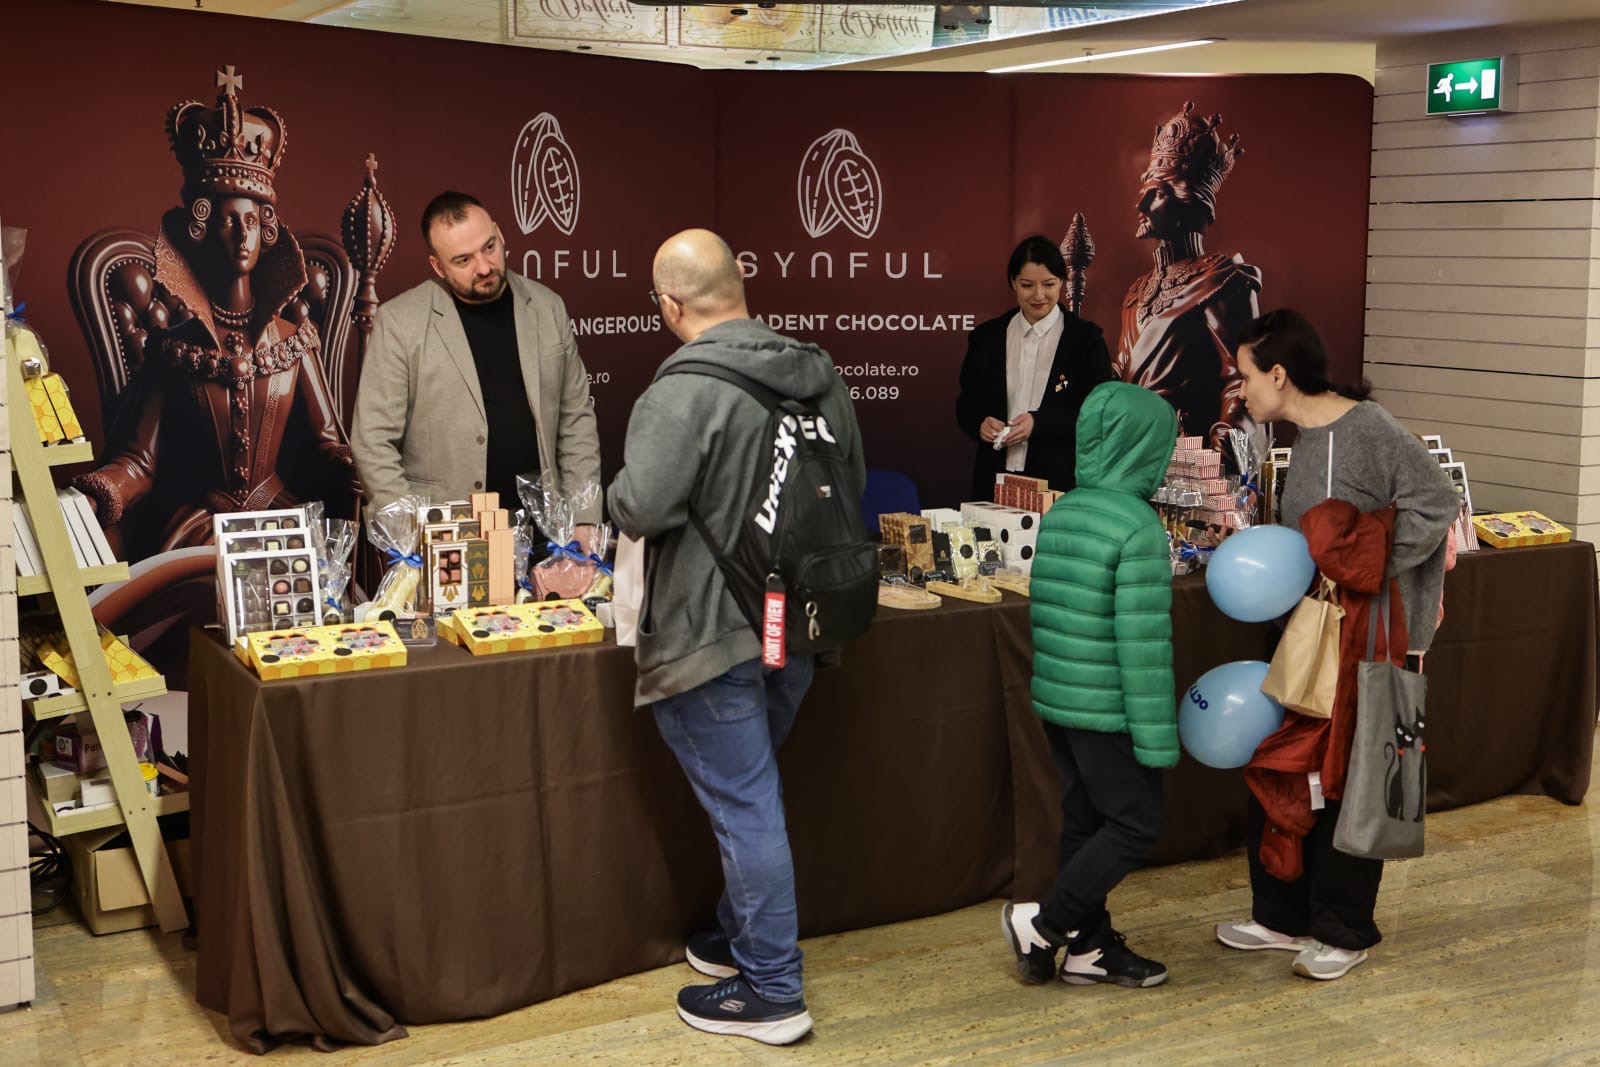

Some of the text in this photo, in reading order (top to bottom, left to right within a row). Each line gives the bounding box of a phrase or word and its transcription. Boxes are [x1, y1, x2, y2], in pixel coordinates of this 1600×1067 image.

[505, 249, 627, 279] NFUL
[569, 314, 661, 335] ANGEROUS
[835, 313, 976, 331] CHOCOLATE
[586, 372, 610, 384] e.ro
[833, 362, 919, 376] ocolate.ro
[846, 386, 900, 400] 6.089
[765, 598, 783, 666] POINT OF VIEW
